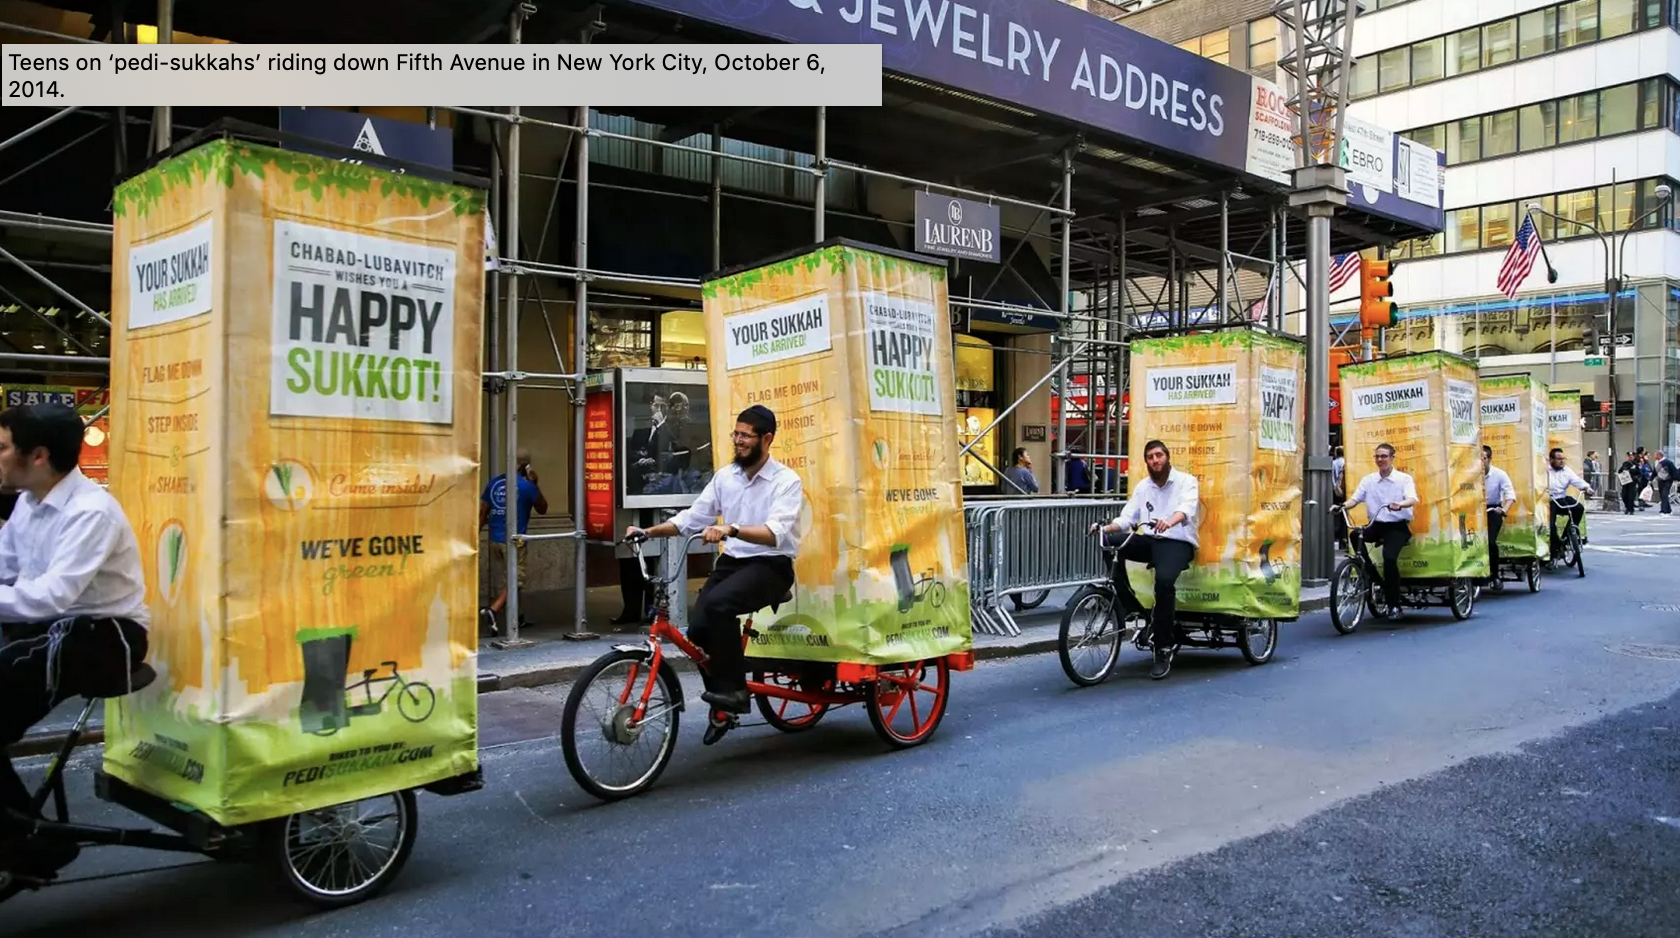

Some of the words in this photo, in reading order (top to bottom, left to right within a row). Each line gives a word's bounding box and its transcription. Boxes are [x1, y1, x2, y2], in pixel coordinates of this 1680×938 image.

[1070, 47, 1224, 137] ADDRESS
[1256, 86, 1291, 118] ROC
[1353, 149, 1383, 172] EBRO
[136, 258, 168, 293] YOUR
[170, 241, 209, 285] SUKKAH
[291, 241, 444, 281] CHABAD-LUBAVITCH
[335, 270, 376, 286] WISHES
[379, 277, 399, 290] YOU
[401, 282, 409, 291] A
[289, 281, 443, 354] HAPPY
[732, 321, 769, 346] YOUR
[771, 307, 823, 338] SUKKAH
[752, 342, 769, 358] HAS
[770, 333, 807, 353] ARRIVED!
[872, 330, 933, 371] HAPPY
[143, 365, 165, 383] FLAG
[286, 347, 440, 403] SUKKOT!
[874, 368, 935, 402] SUKKOT!
[1153, 376, 1183, 391] YOUR
[1185, 373, 1231, 390] SUKKAH
[9, 391, 75, 408] SALE
[747, 389, 772, 403] FLAG
[774, 386, 788, 398] ME
[791, 380, 819, 396] DOWN
[1168, 391, 1183, 400] HAS
[1358, 392, 1383, 406] YOUR
[1385, 387, 1424, 403] SUKKAH
[1262, 391, 1295, 420] HAPPY
[1449, 399, 1474, 421] HAPPY
[1481, 402, 1516, 414] SUKKAH
[148, 416, 171, 433] STEP
[172, 413, 199, 432] INSIDE
[783, 415, 815, 431] INSIDE
[1160, 424, 1181, 433] FLAG
[1183, 424, 1195, 432] ME
[1197, 422, 1222, 432] DOWN
[1169, 447, 1186, 455] TEP
[1188, 446, 1215, 455] INSIDE
[329, 474, 378, 496] Come
[381, 474, 436, 494] inside!
[301, 537, 364, 560] WE'VE
[368, 535, 424, 556] GONE
[322, 552, 408, 596] green!
